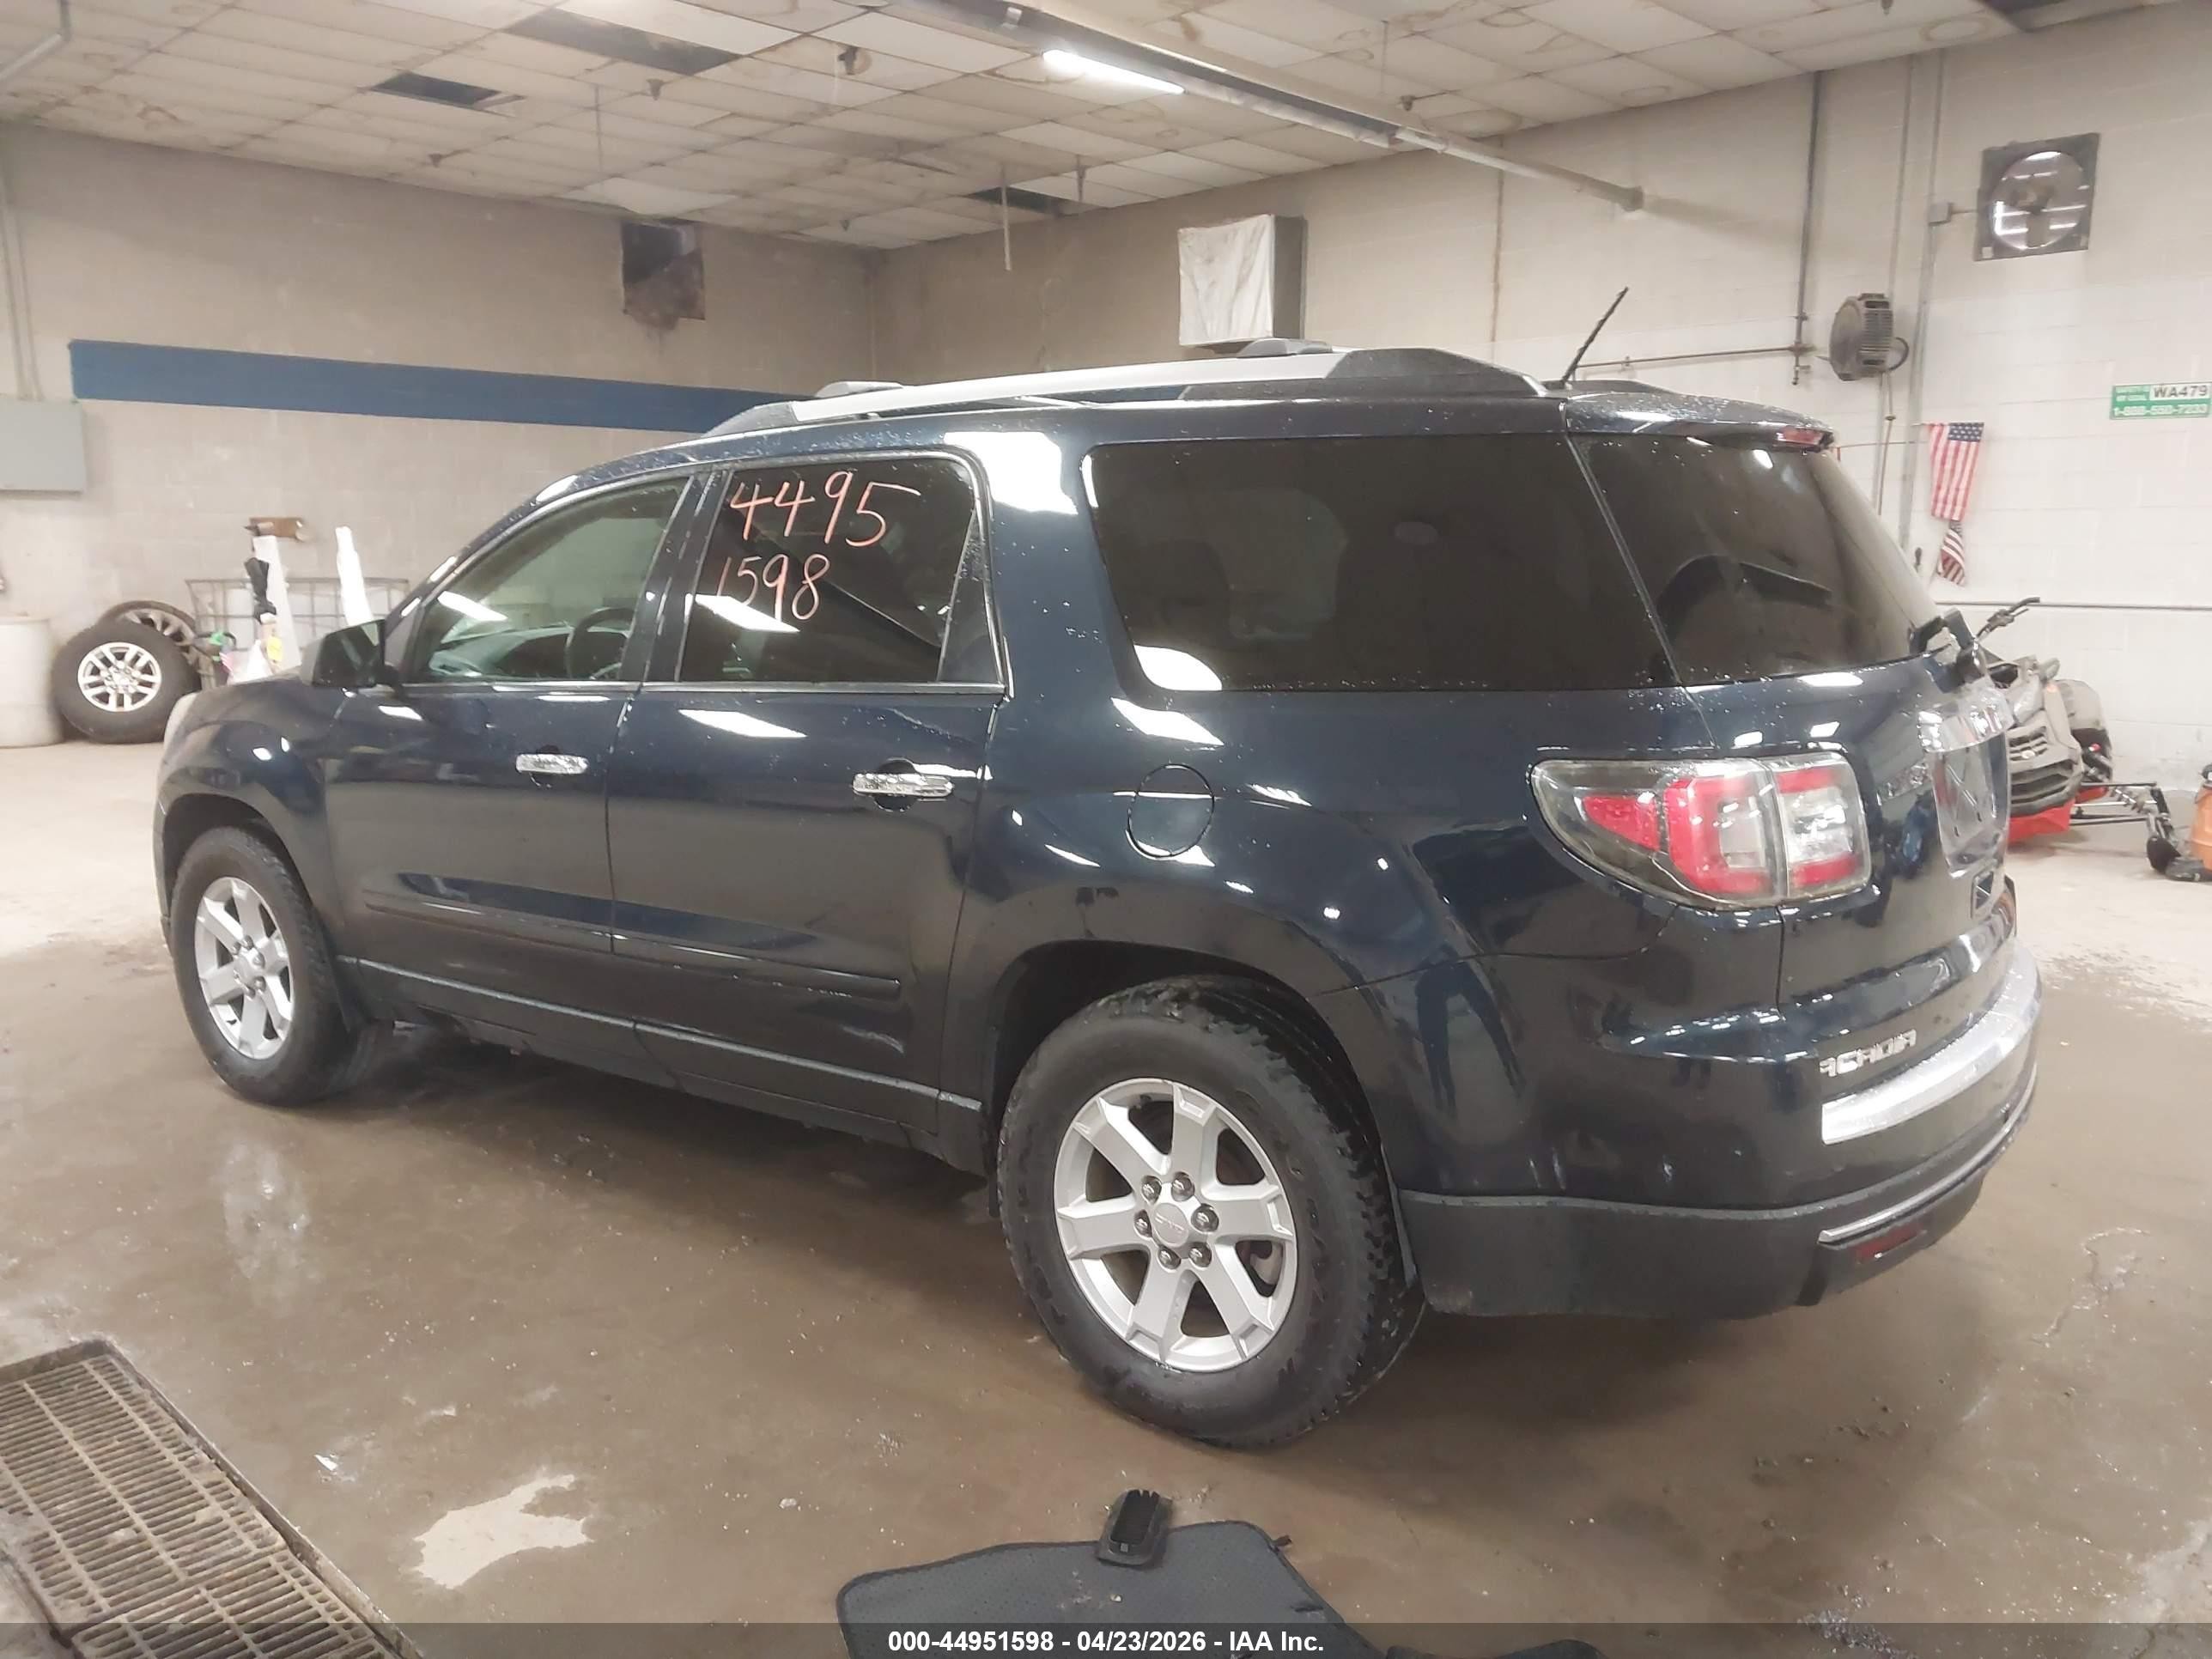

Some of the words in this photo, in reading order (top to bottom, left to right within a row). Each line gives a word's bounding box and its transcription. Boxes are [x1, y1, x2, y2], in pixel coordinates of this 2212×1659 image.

[2153, 385, 2208, 398] WA479
[730, 471, 921, 547] 4495
[716, 553, 830, 620] 1598
